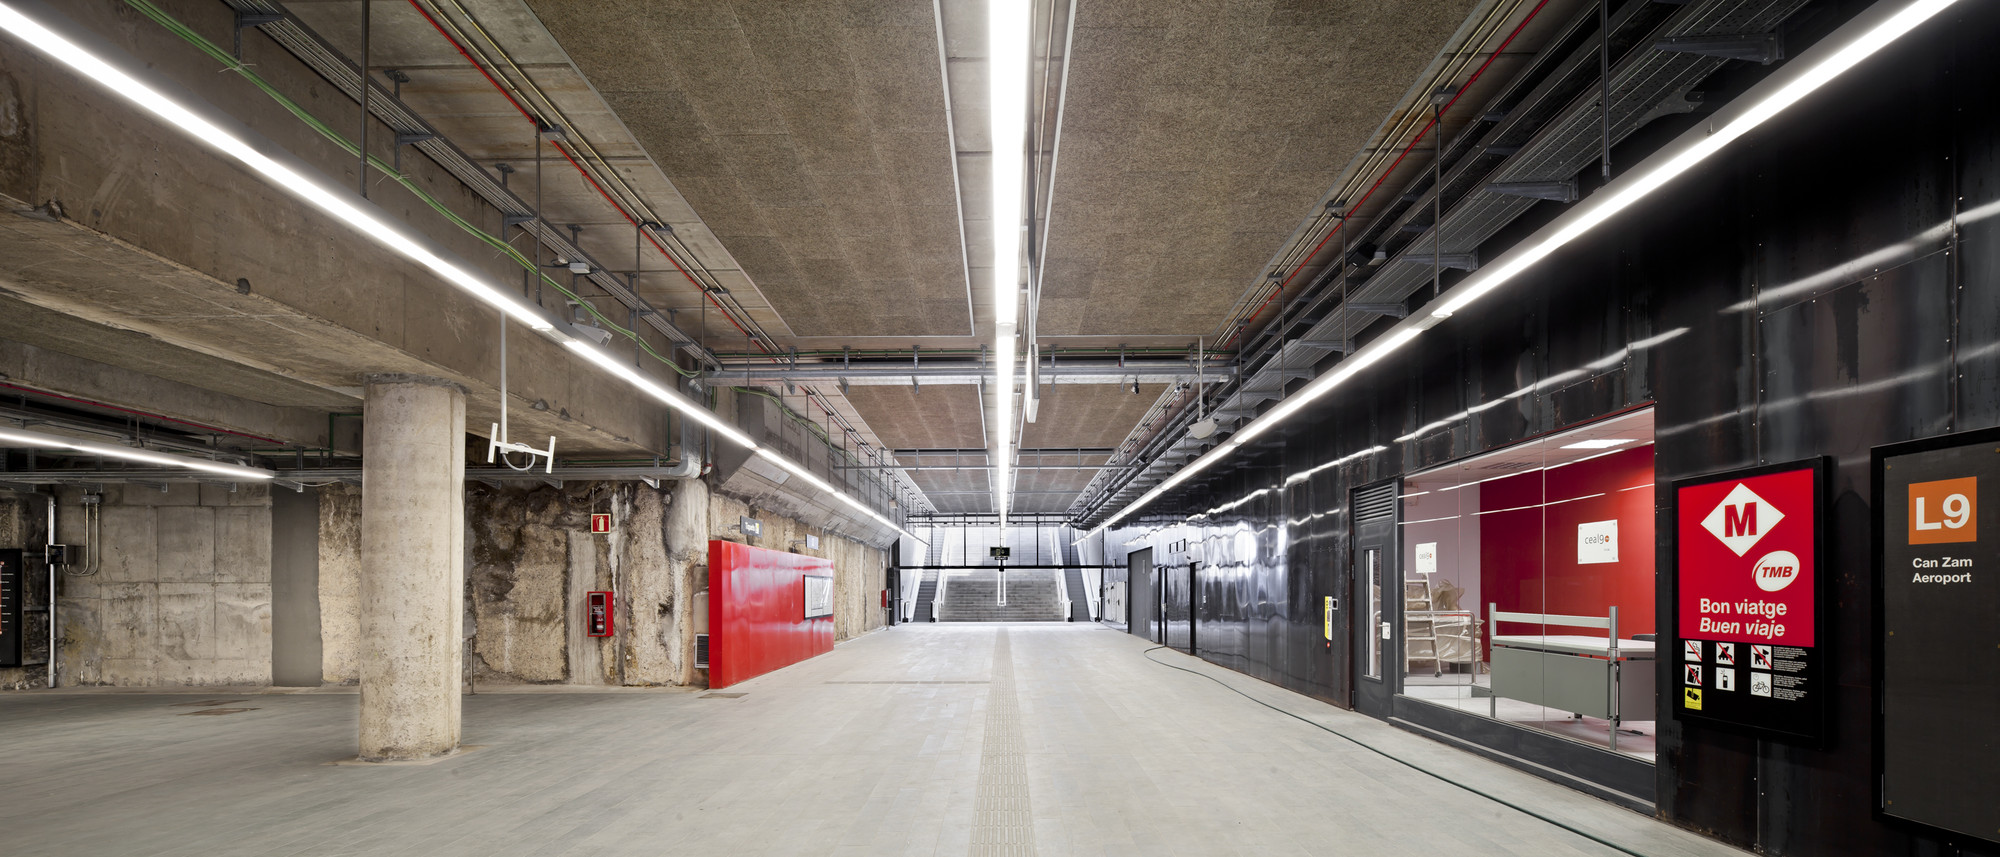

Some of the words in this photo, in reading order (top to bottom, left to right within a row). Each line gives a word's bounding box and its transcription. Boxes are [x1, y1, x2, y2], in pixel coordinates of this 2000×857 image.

[1724, 501, 1757, 538] M
[1916, 493, 1970, 531] L9
[1762, 566, 1793, 578] TMB
[1912, 557, 1938, 568] Can
[1942, 556, 1973, 568] Zam
[1912, 572, 1972, 585] Aeroport
[1700, 598, 1730, 614] Bon
[1734, 599, 1787, 619] viatge
[1699, 617, 1740, 634] Buen
[1745, 619, 1786, 640] viaje
